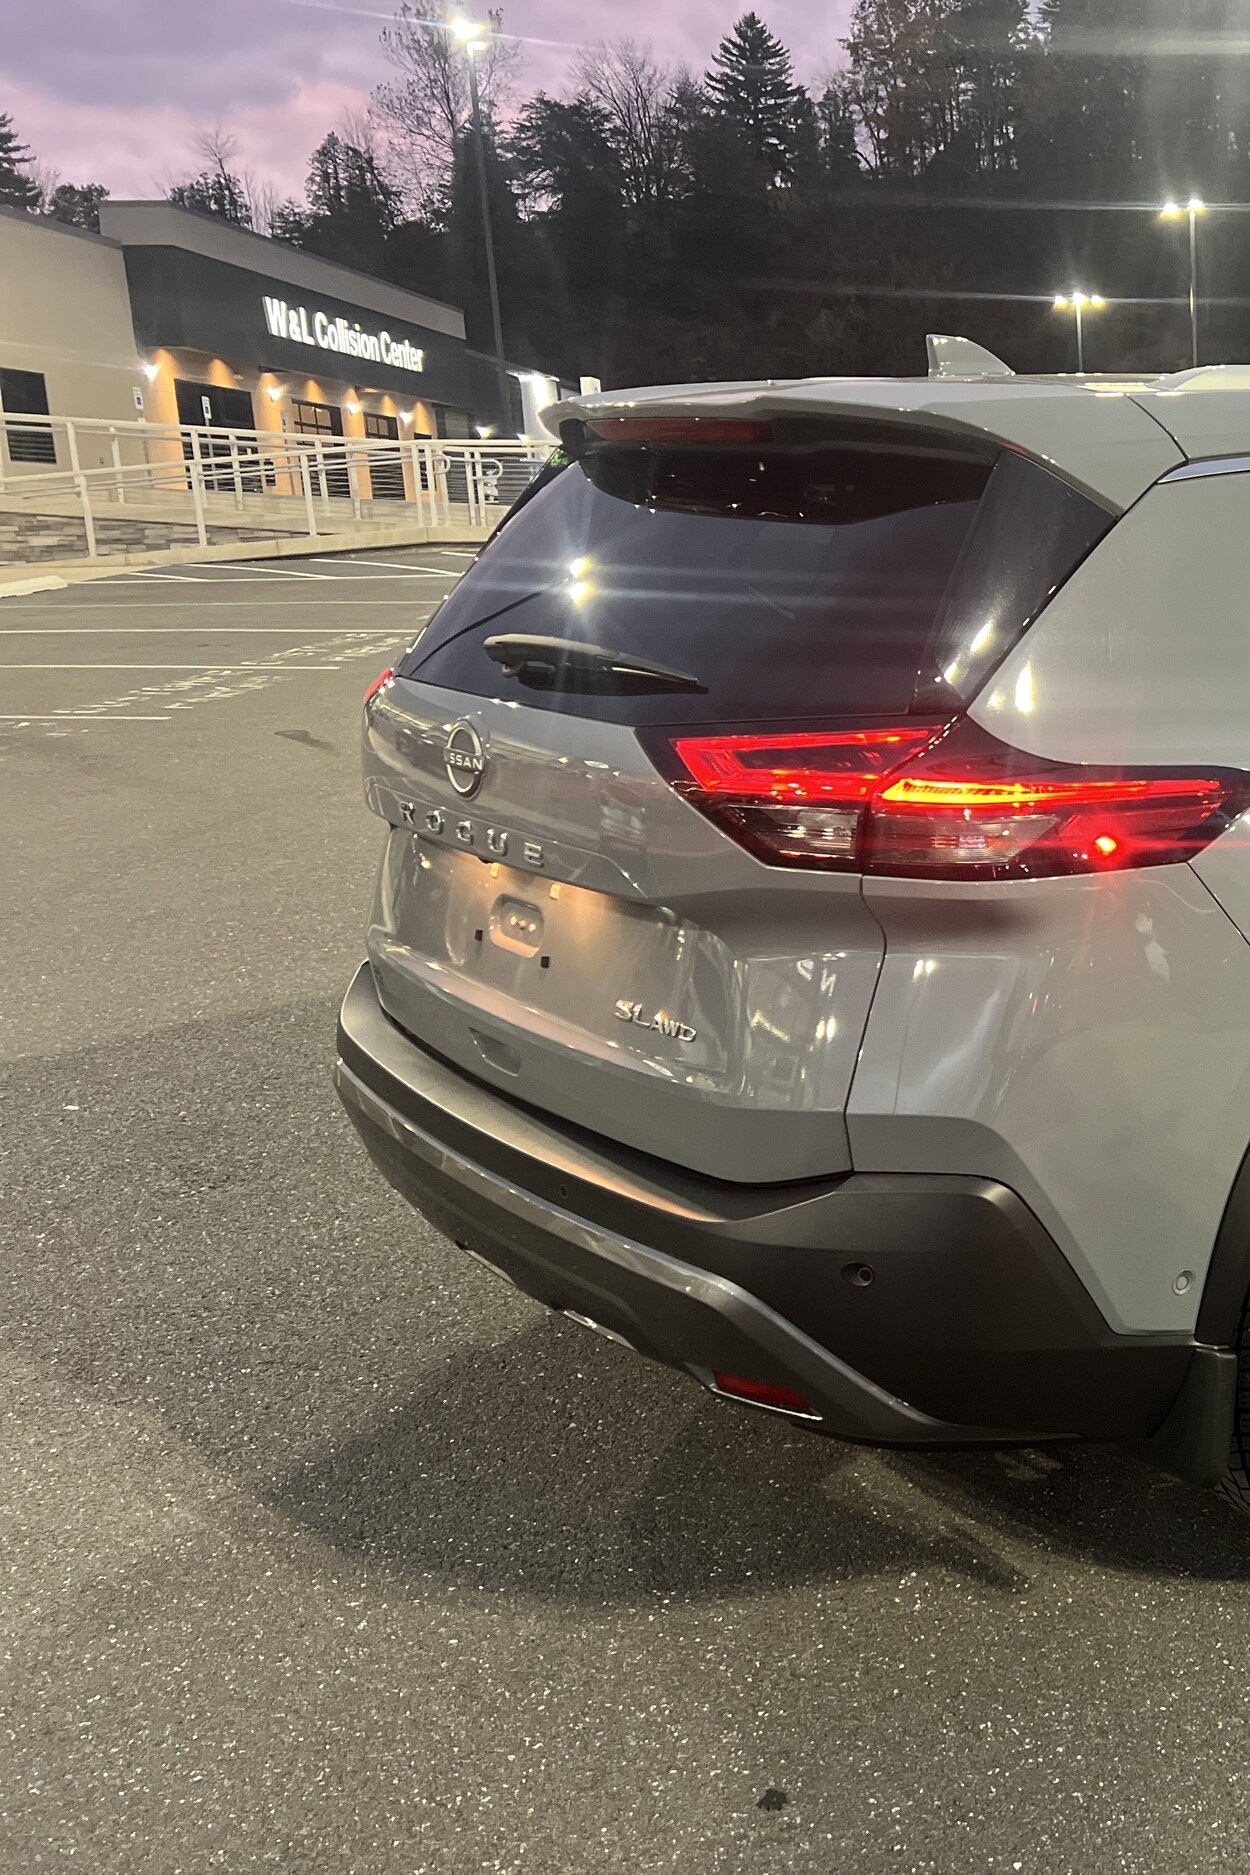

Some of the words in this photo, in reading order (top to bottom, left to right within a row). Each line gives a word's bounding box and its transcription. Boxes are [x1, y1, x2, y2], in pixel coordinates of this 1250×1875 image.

[262, 295, 315, 346] W&L
[313, 311, 381, 363] Collision
[379, 331, 425, 373] Center
[400, 801, 545, 868] ROGUE
